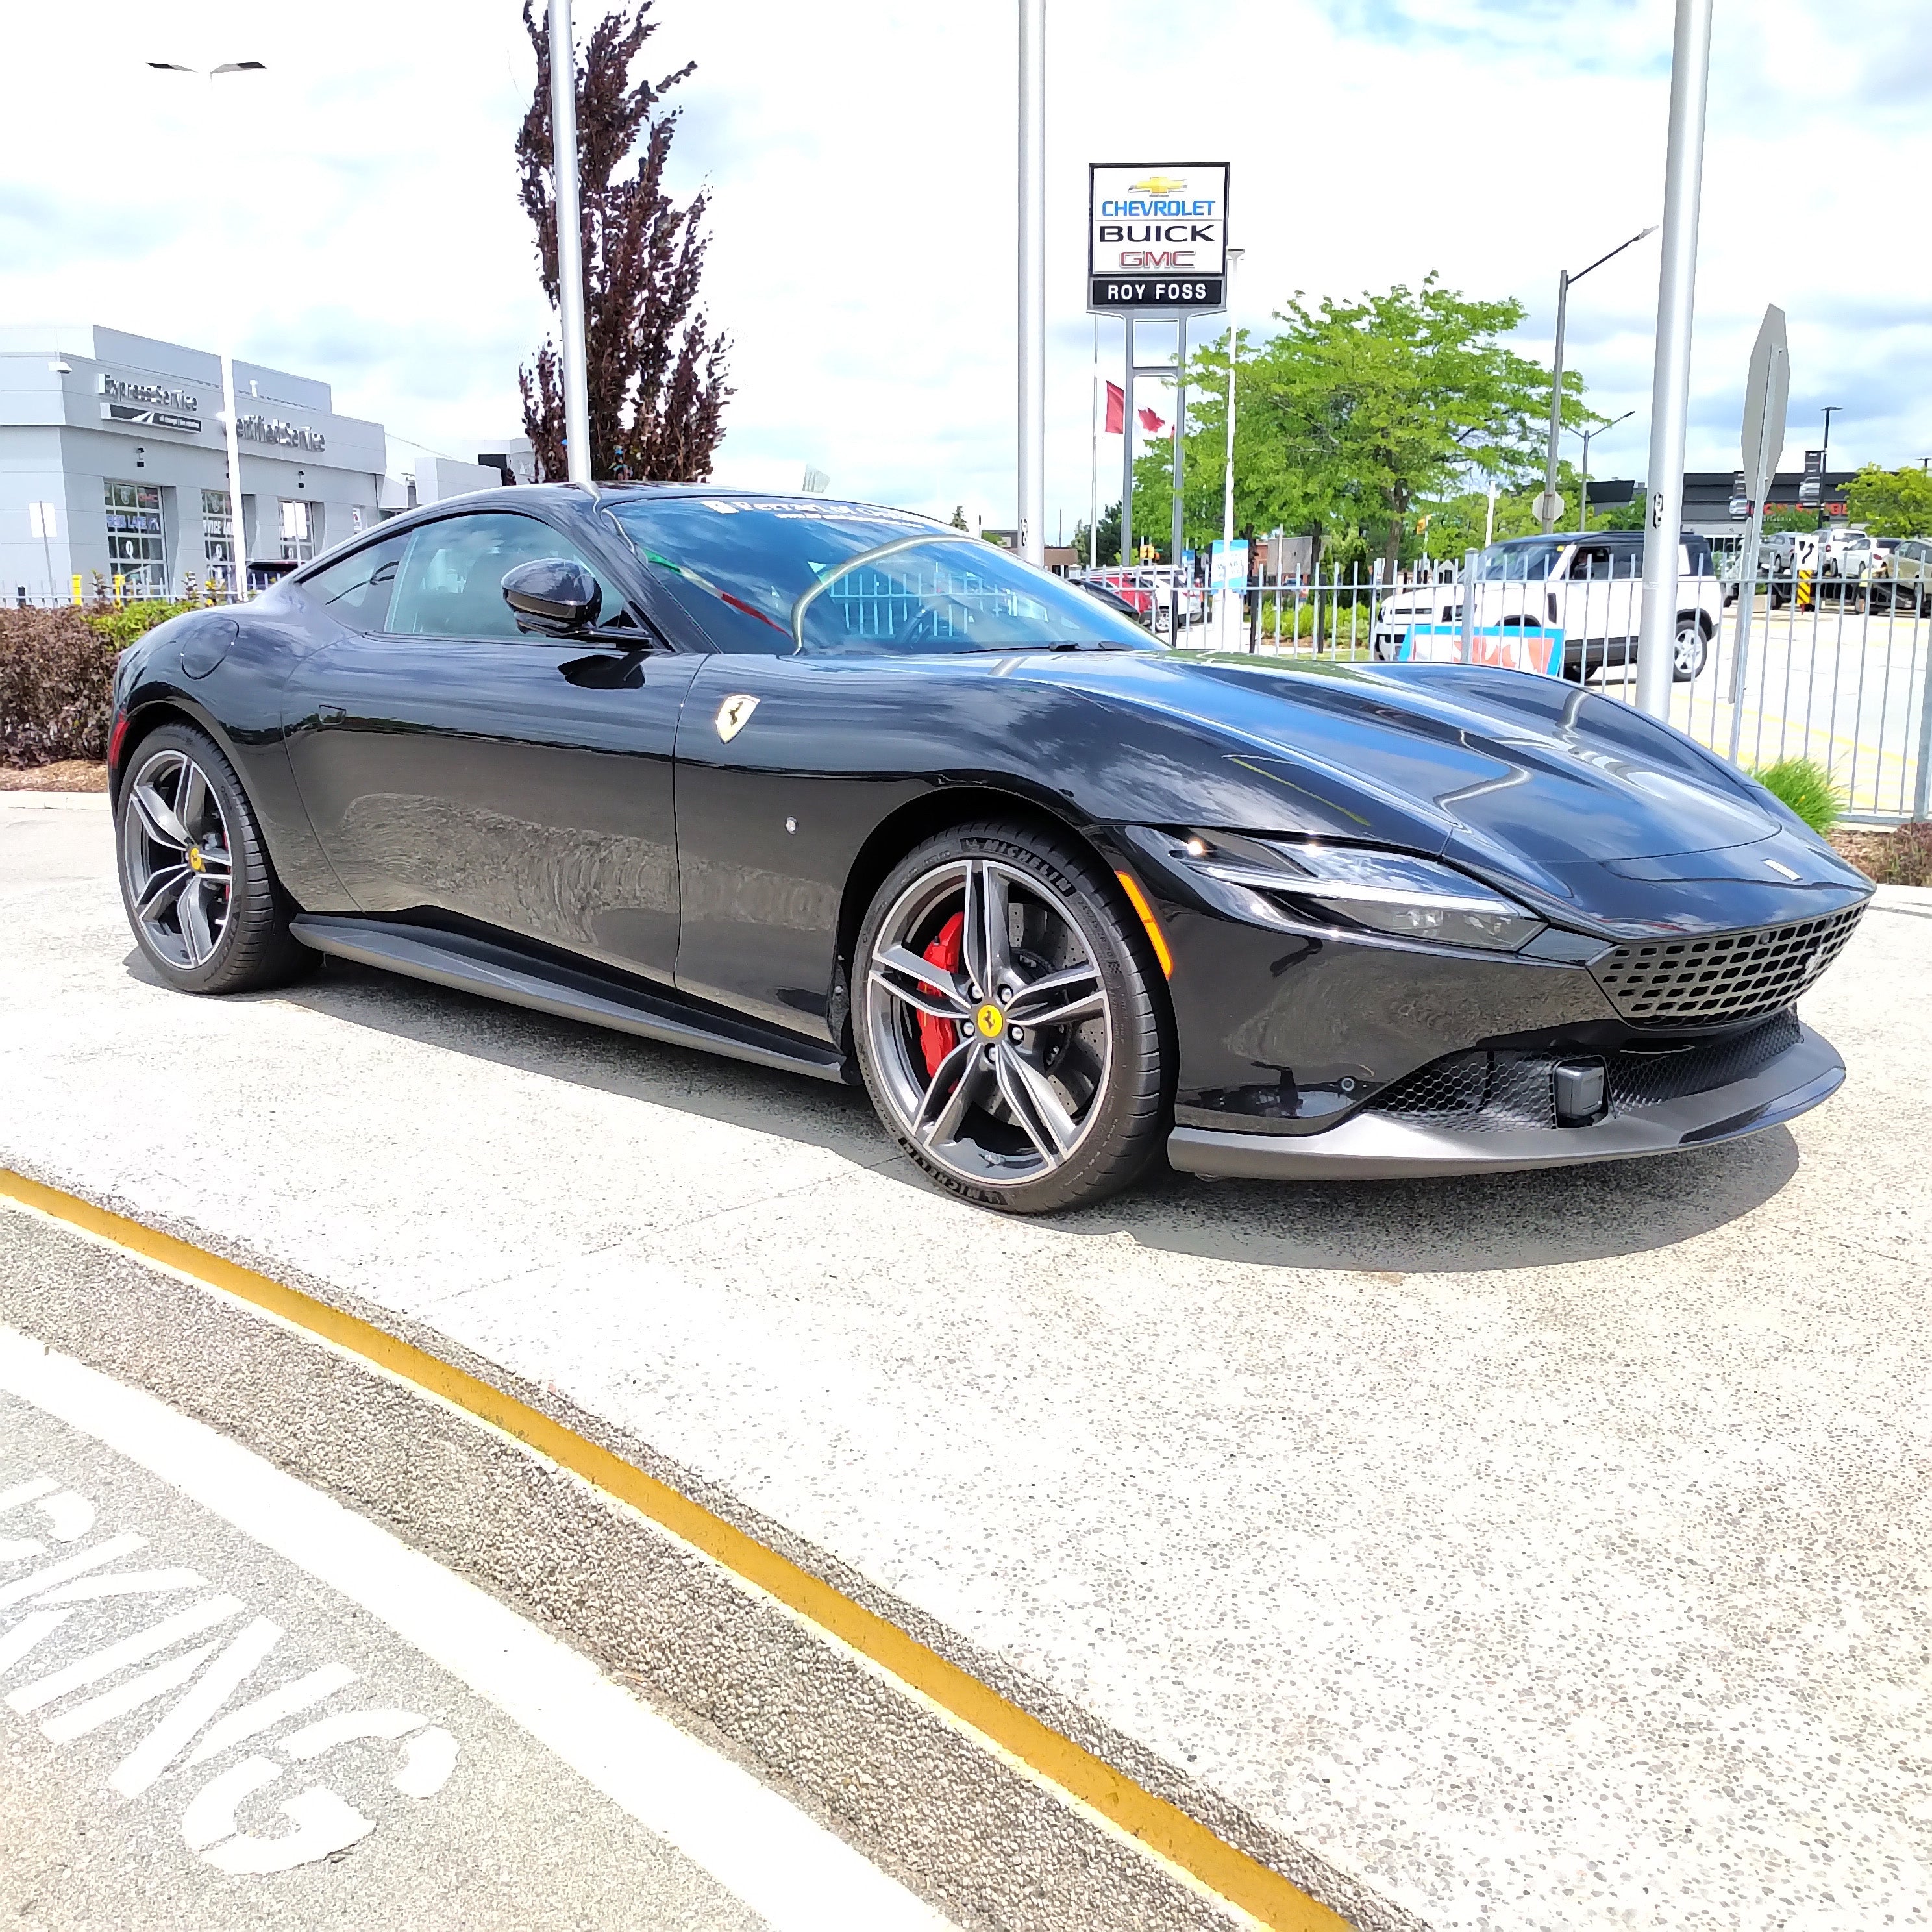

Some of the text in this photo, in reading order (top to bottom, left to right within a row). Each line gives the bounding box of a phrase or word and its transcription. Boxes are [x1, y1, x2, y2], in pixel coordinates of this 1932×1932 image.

[1102, 200, 1215, 217] CHEVROLET
[1099, 225, 1215, 243] BUICK
[1119, 251, 1196, 269] GMC
[1108, 284, 1207, 301] ROY FOSS
[99, 373, 198, 412] Express Service
[221, 414, 279, 444] ertified
[982, 839, 1072, 891] MICHELIN
[903, 1142, 981, 1200] MICHELIN
